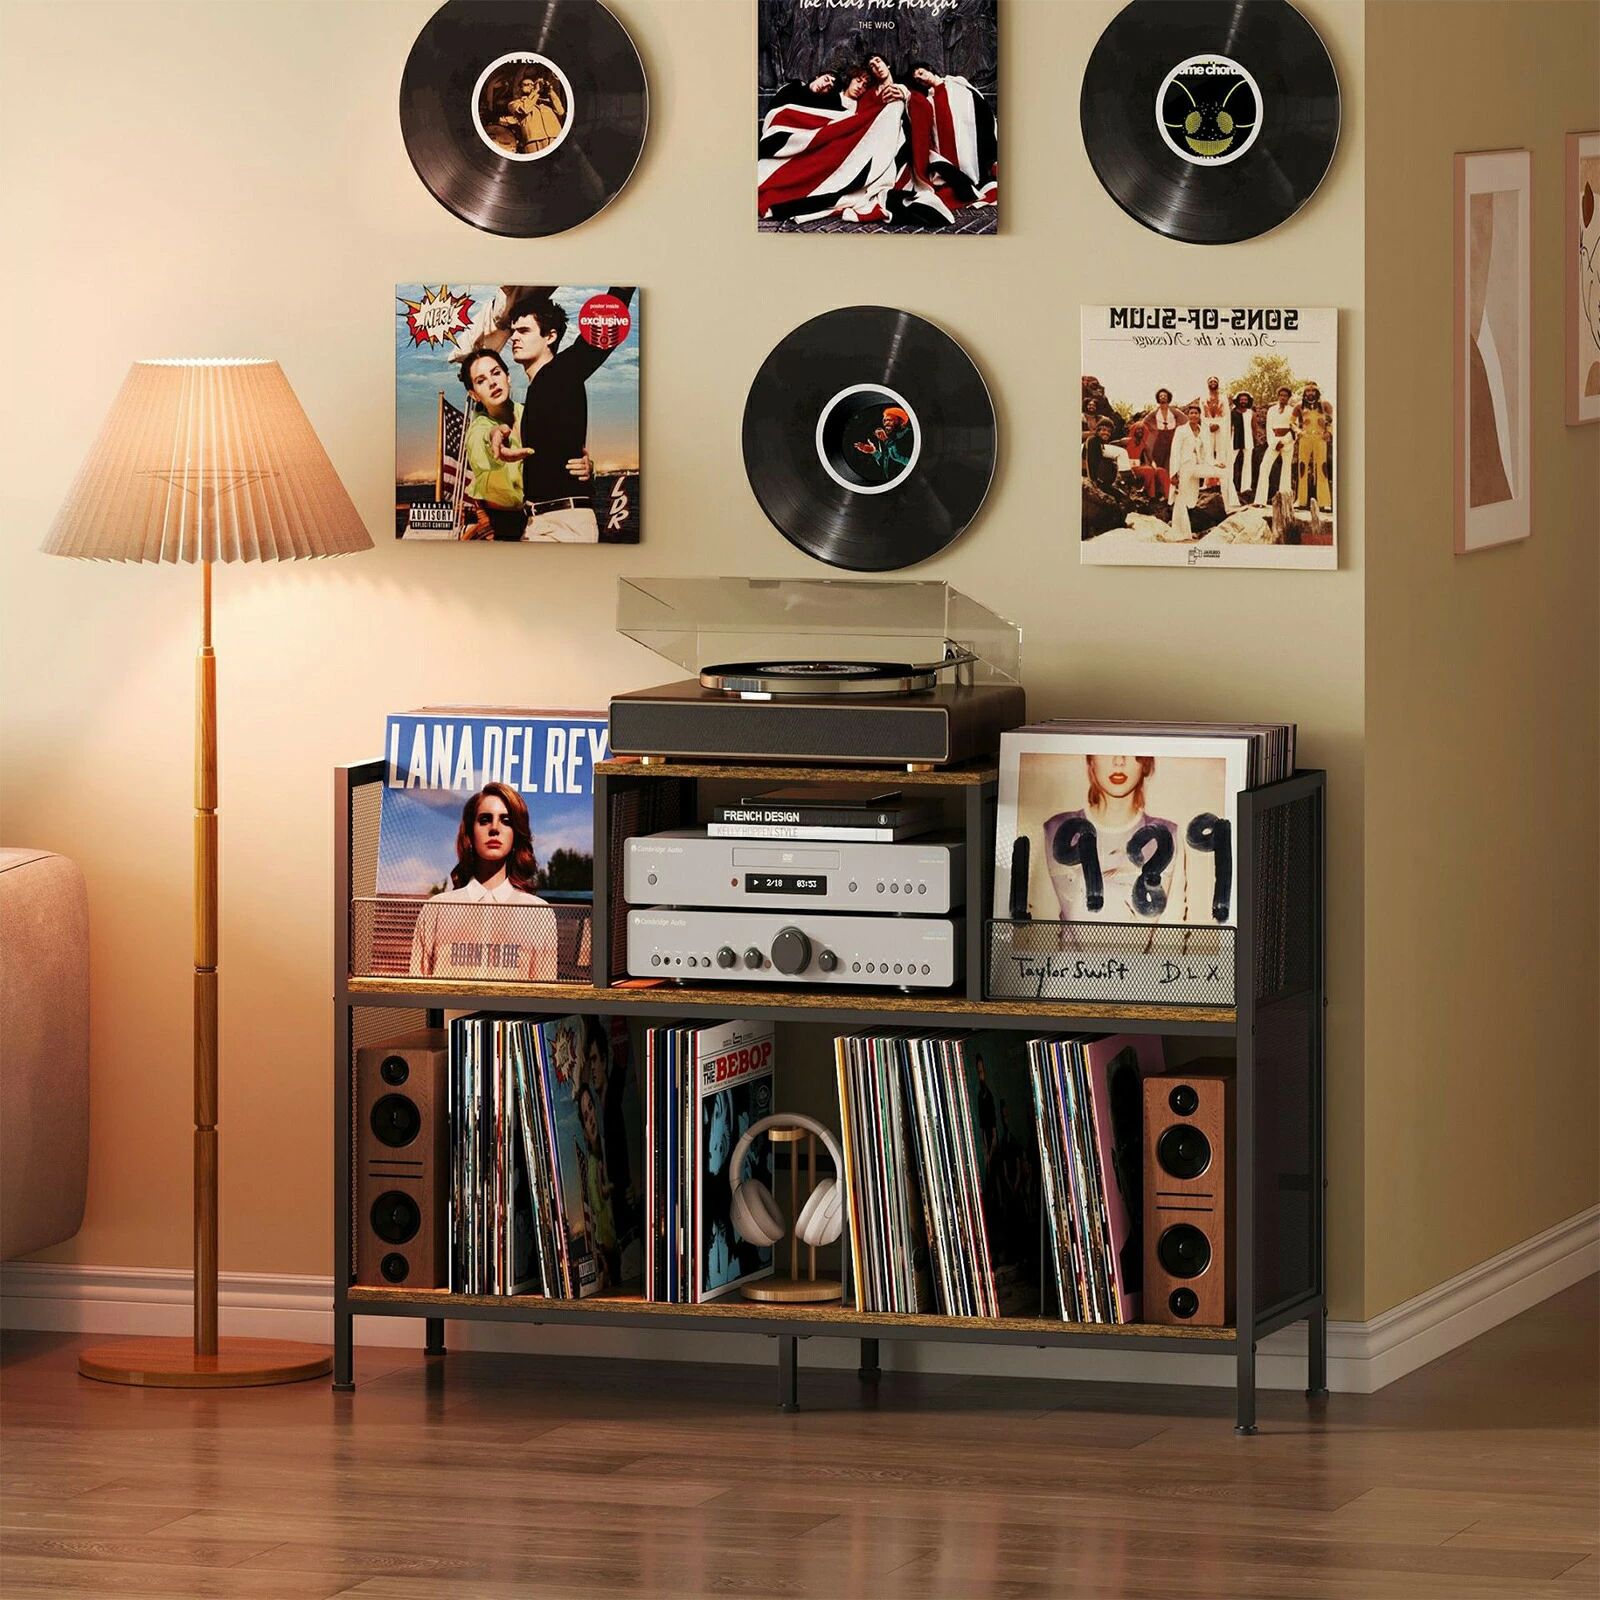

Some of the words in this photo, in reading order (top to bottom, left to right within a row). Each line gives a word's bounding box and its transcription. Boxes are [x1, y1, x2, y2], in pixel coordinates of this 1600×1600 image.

[858, 21, 872, 29] THE
[874, 21, 896, 29] WHO
[580, 315, 629, 327] exclusive
[411, 510, 452, 521] ADVISORY
[389, 723, 475, 791] LANA
[481, 726, 538, 793] DEL
[544, 727, 608, 794] REY
[723, 810, 762, 821] FRENCH
[764, 811, 800, 823] DESIGN
[774, 827, 799, 838] STYLE
[1009, 812, 1233, 928] 1989
[766, 878, 783, 887] 2/18
[450, 942, 482, 968] BORN
[1011, 957, 1070, 998] Taylor
[1073, 959, 1130, 981] Swift
[703, 1060, 716, 1073] MEET
[716, 1041, 772, 1082] BEBOP
[703, 1071, 716, 1086] THE
